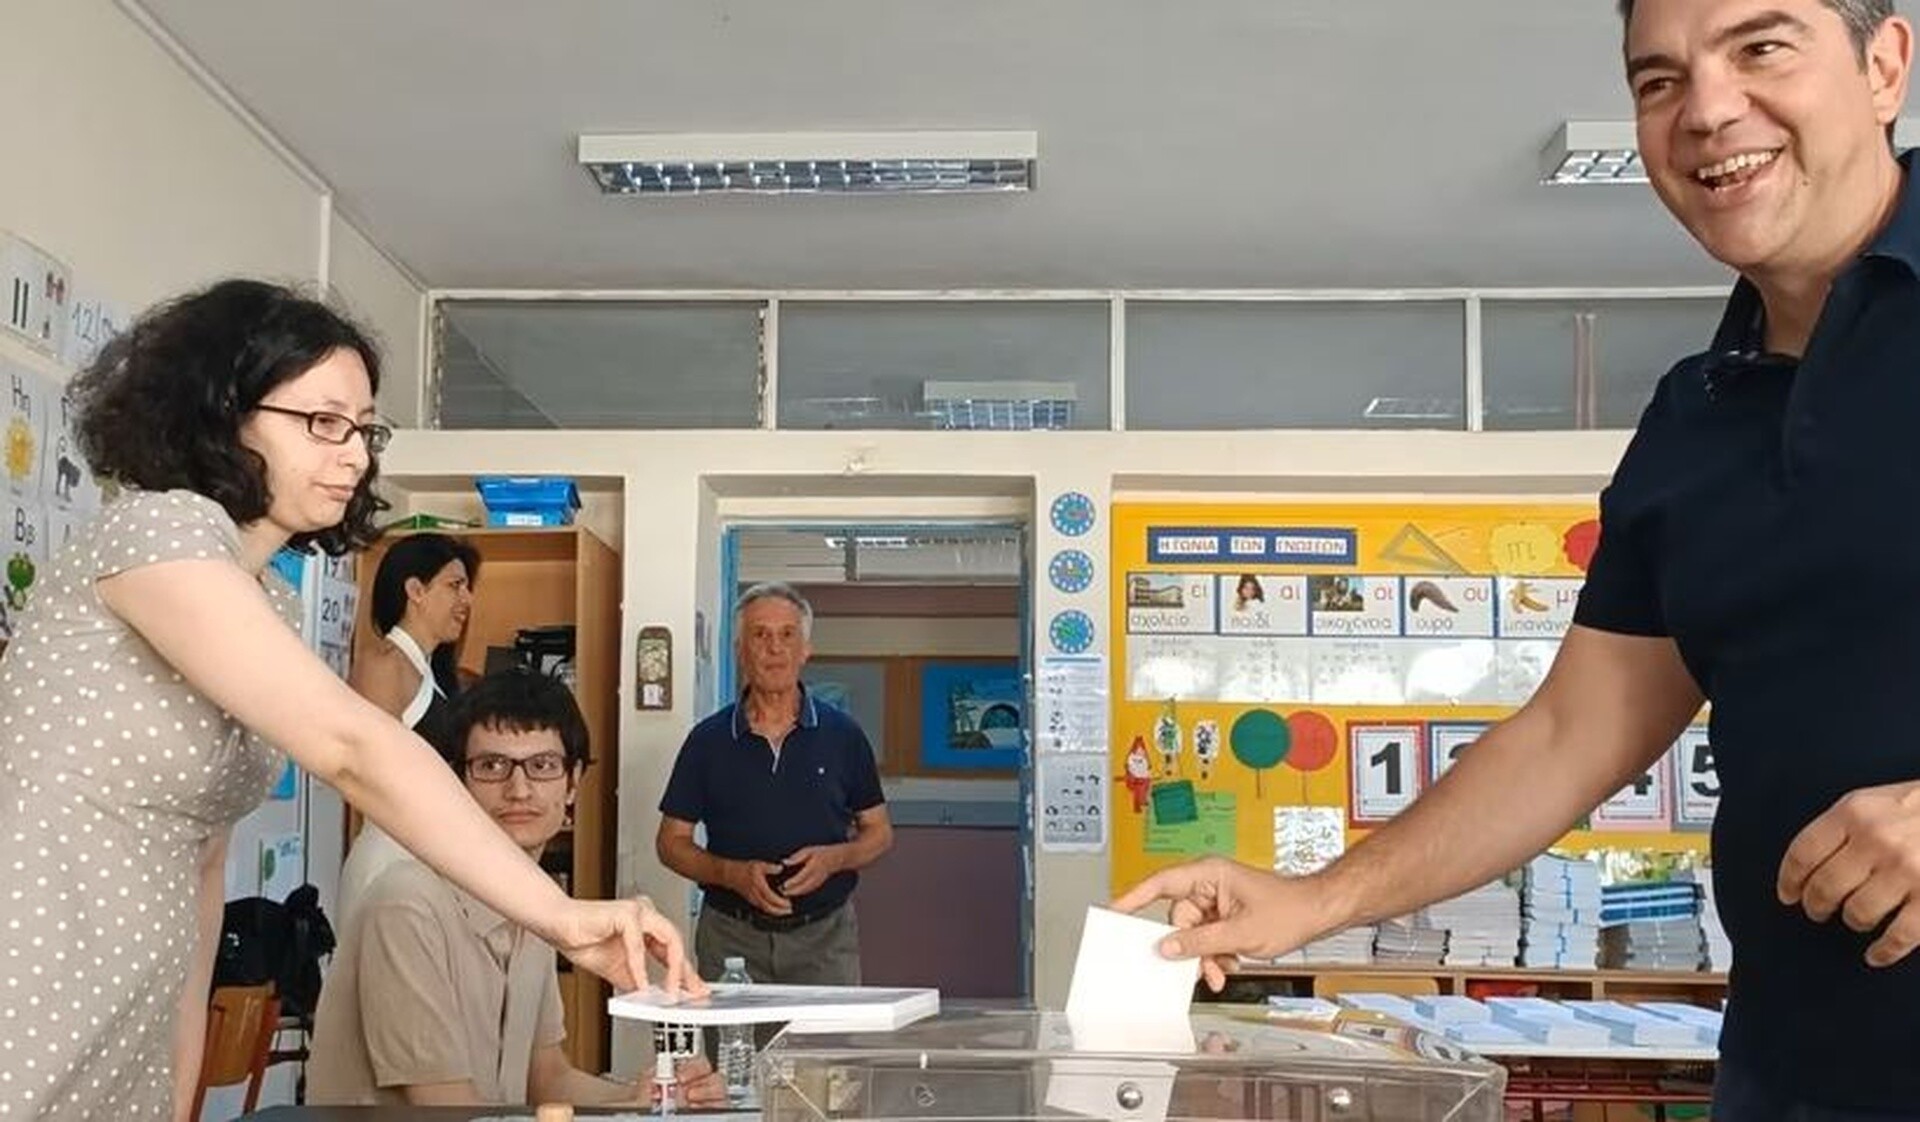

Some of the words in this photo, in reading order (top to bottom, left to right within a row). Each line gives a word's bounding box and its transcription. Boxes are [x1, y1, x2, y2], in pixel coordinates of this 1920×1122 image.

[321, 598, 340, 623] 20
[1371, 742, 1402, 795] 1
[1691, 745, 1721, 797] 5
